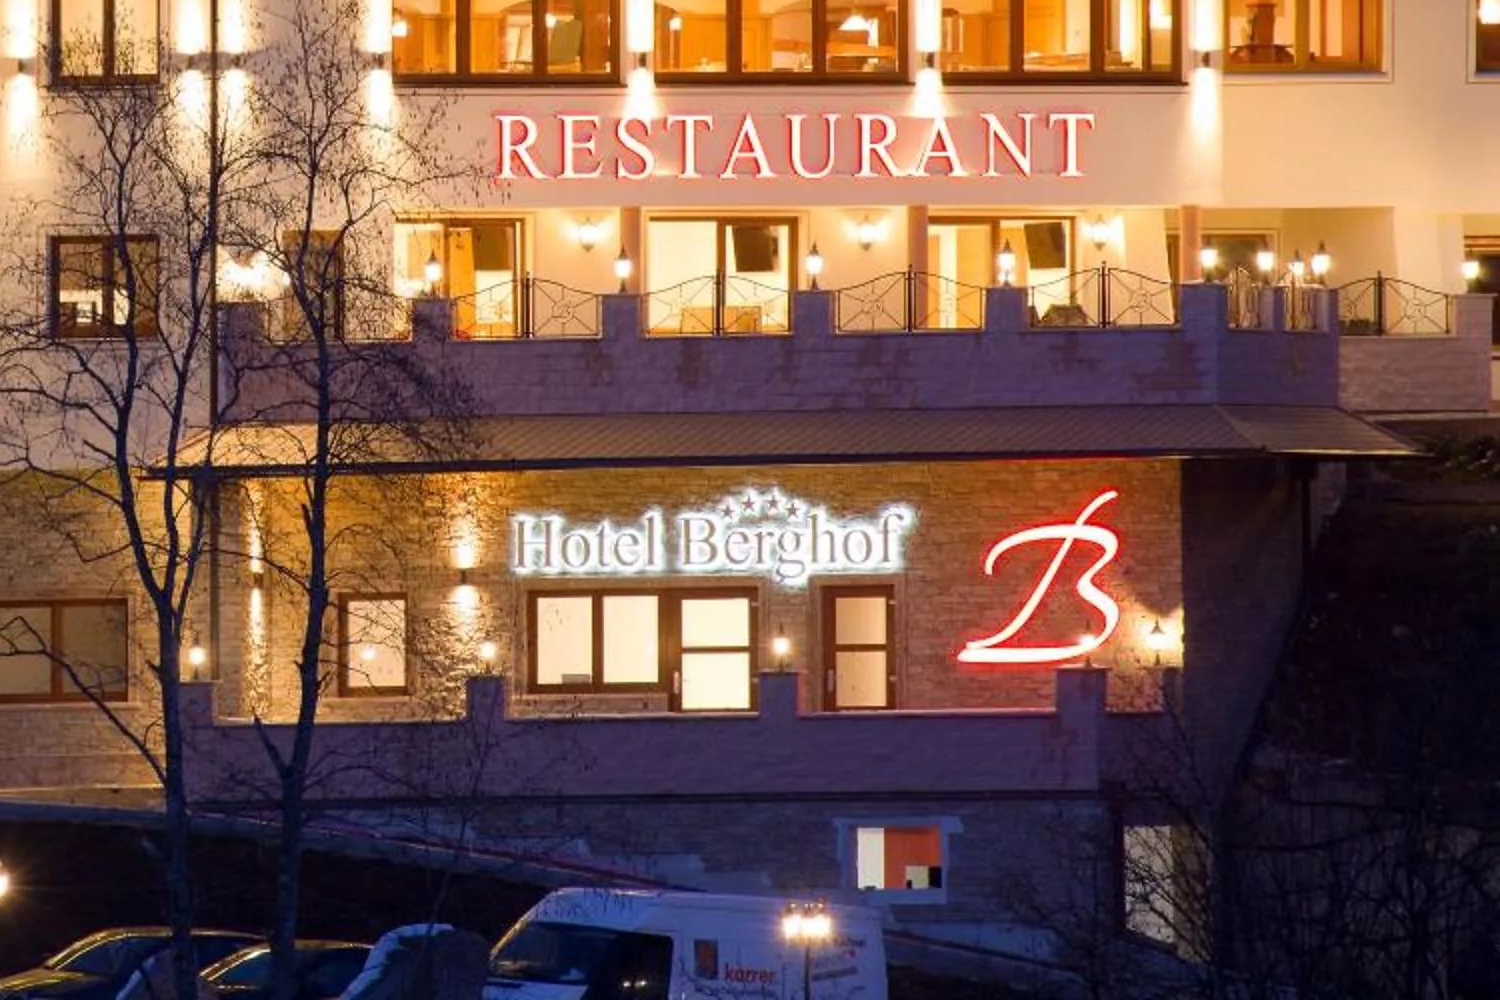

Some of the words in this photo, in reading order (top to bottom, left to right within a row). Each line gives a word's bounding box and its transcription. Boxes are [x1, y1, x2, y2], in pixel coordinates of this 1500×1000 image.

[493, 112, 1096, 181] RESTAURANT
[512, 510, 658, 568] Hotel
[679, 512, 906, 582] Berghof
[957, 490, 1120, 663] B
